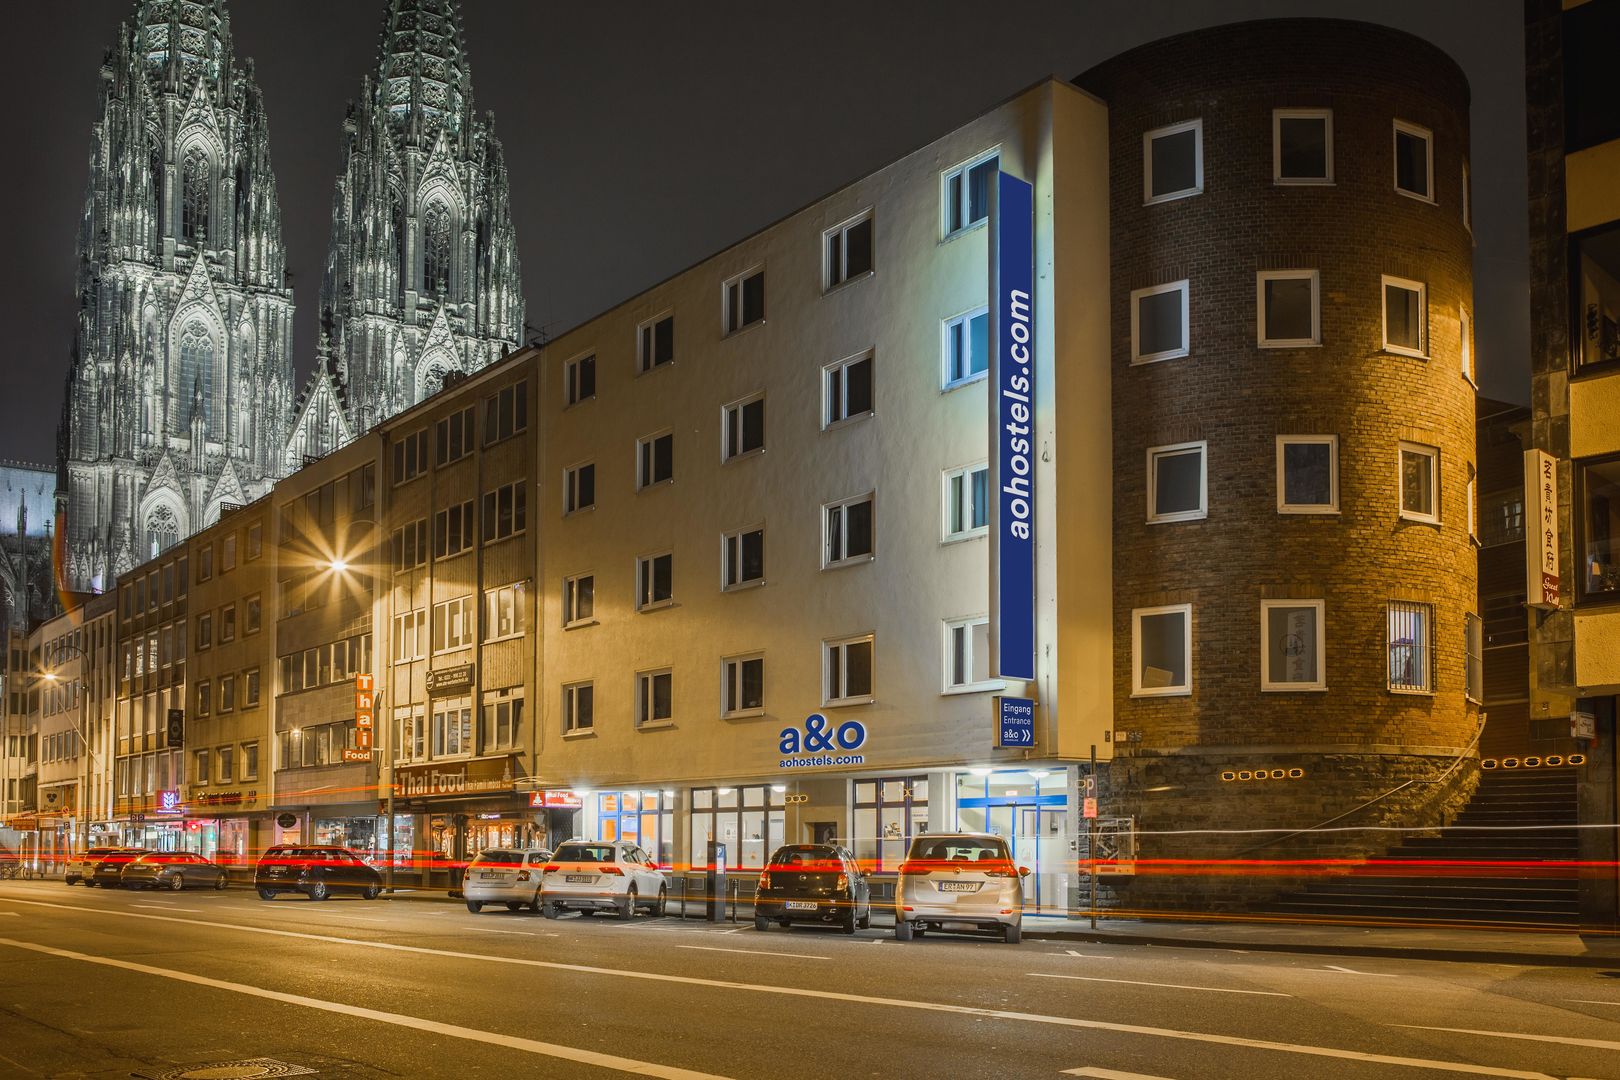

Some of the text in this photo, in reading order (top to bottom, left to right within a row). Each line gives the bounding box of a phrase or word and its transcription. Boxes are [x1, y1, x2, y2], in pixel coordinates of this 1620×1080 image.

[1003, 289, 1030, 540] aohostels.com
[1542, 577, 1558, 591] Great
[1545, 591, 1559, 606] Wall
[359, 675, 372, 746] Thai
[1003, 703, 1032, 715] Eingang
[1003, 715, 1032, 726] Entrance
[779, 713, 867, 755] a&o
[1003, 728, 1019, 739] a&o
[344, 750, 370, 760] Food
[779, 755, 865, 769] aohostels.com
[400, 769, 428, 796] Thai
[430, 767, 465, 794] Food
